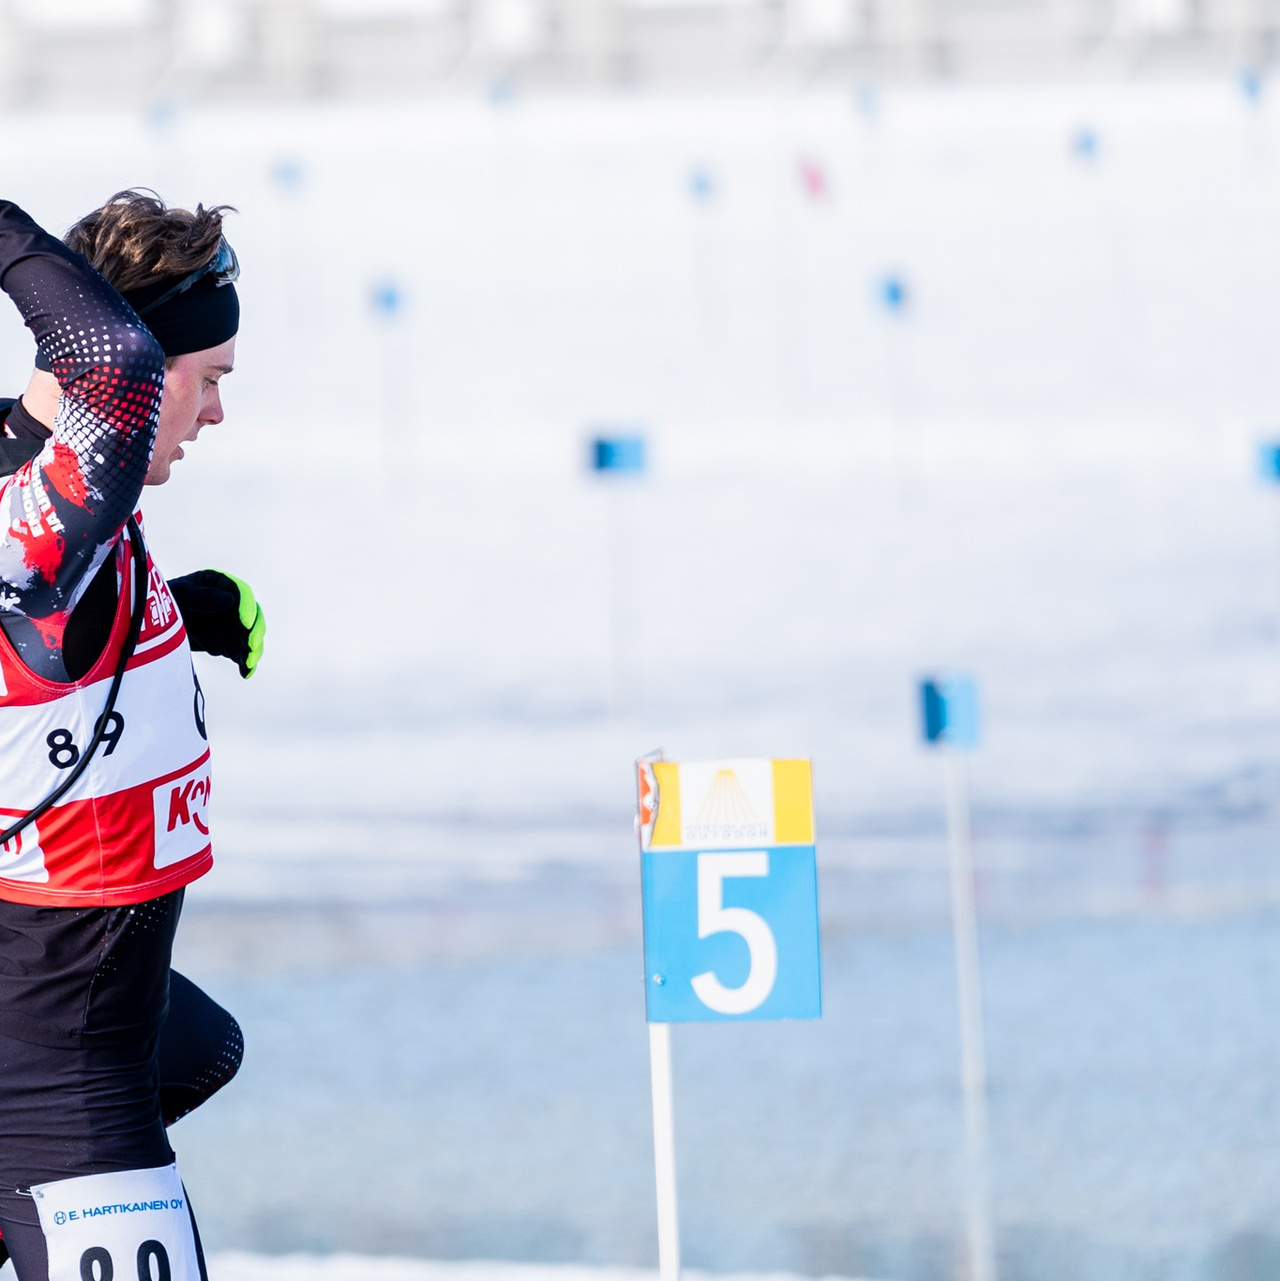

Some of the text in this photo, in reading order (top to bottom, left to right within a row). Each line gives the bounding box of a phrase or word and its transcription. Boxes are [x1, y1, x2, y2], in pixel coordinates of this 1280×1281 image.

[46, 711, 125, 770] 89
[690, 851, 777, 1014] 5
[69, 1211, 80, 1221] E.
[83, 1200, 169, 1218] HARTIKAINEN
[170, 1198, 184, 1210] OY
